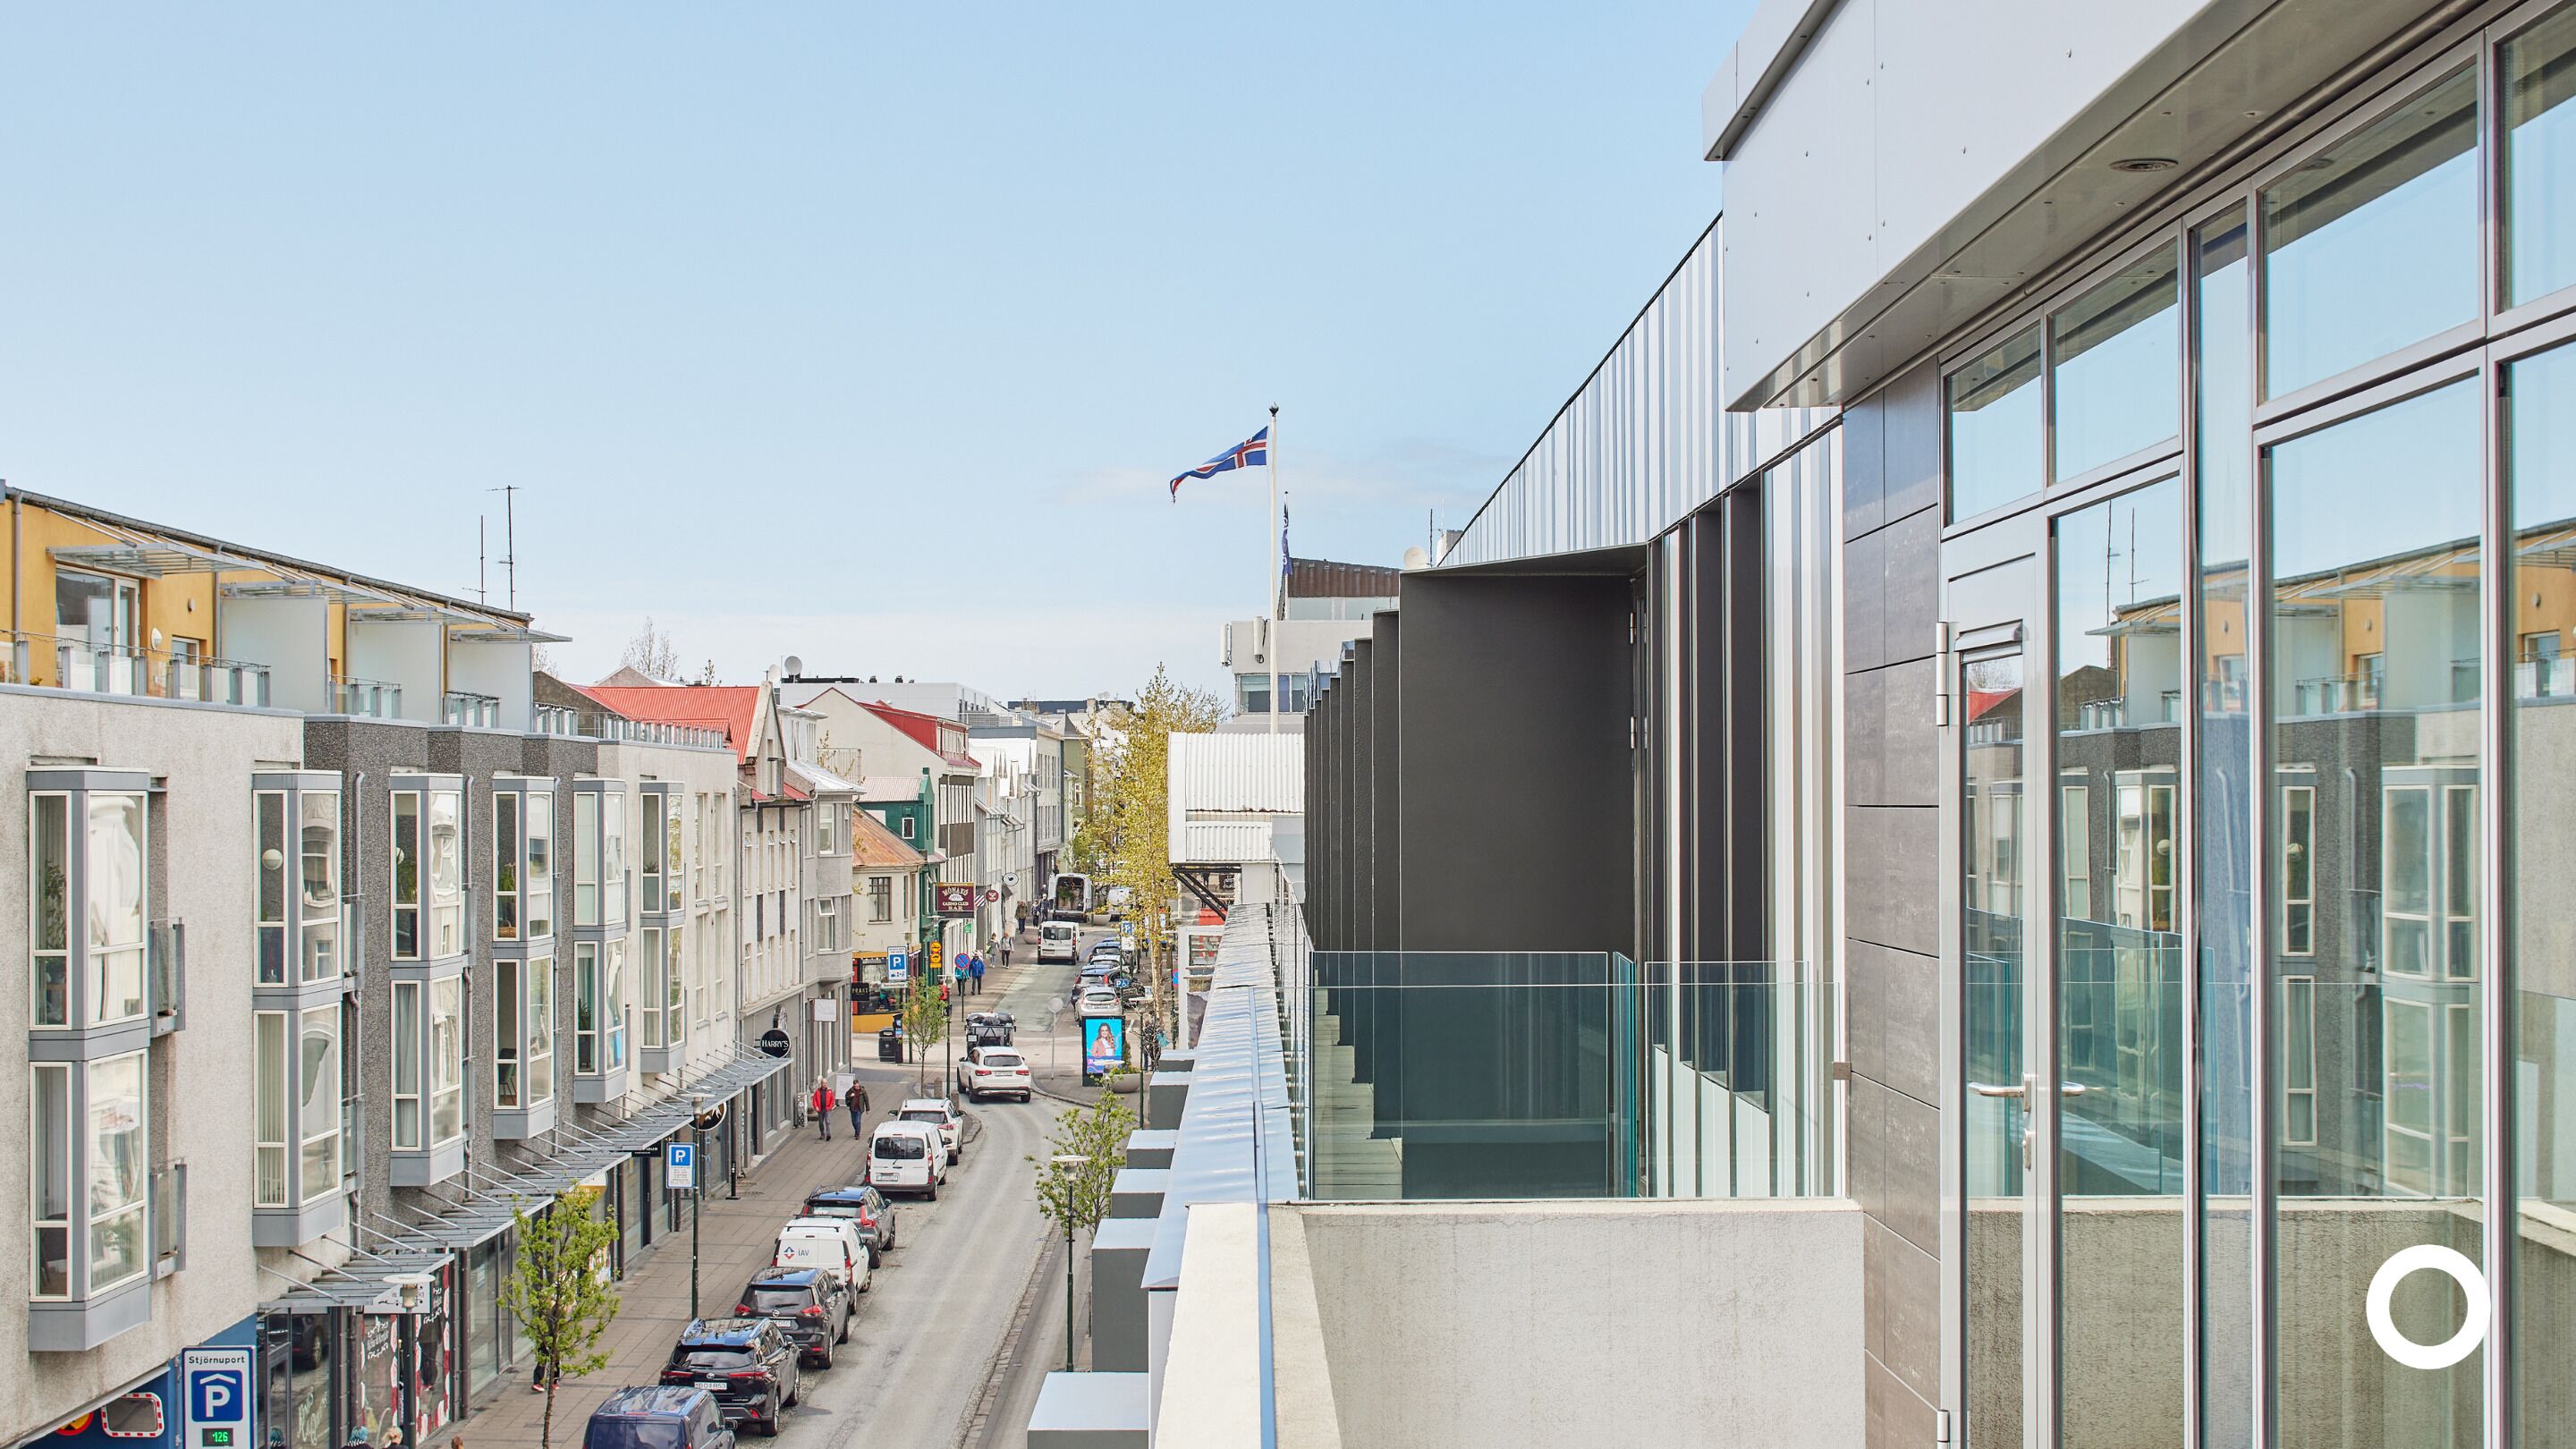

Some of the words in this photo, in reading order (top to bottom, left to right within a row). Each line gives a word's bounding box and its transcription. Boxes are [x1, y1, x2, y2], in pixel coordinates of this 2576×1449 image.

[893, 956, 901, 968] P
[761, 1039, 789, 1048] HARRY'S
[675, 1149, 686, 1163] P
[188, 1355, 245, 1365] Stjörnuport
[206, 1385, 231, 1418] P
[213, 1431, 228, 1443] 126
